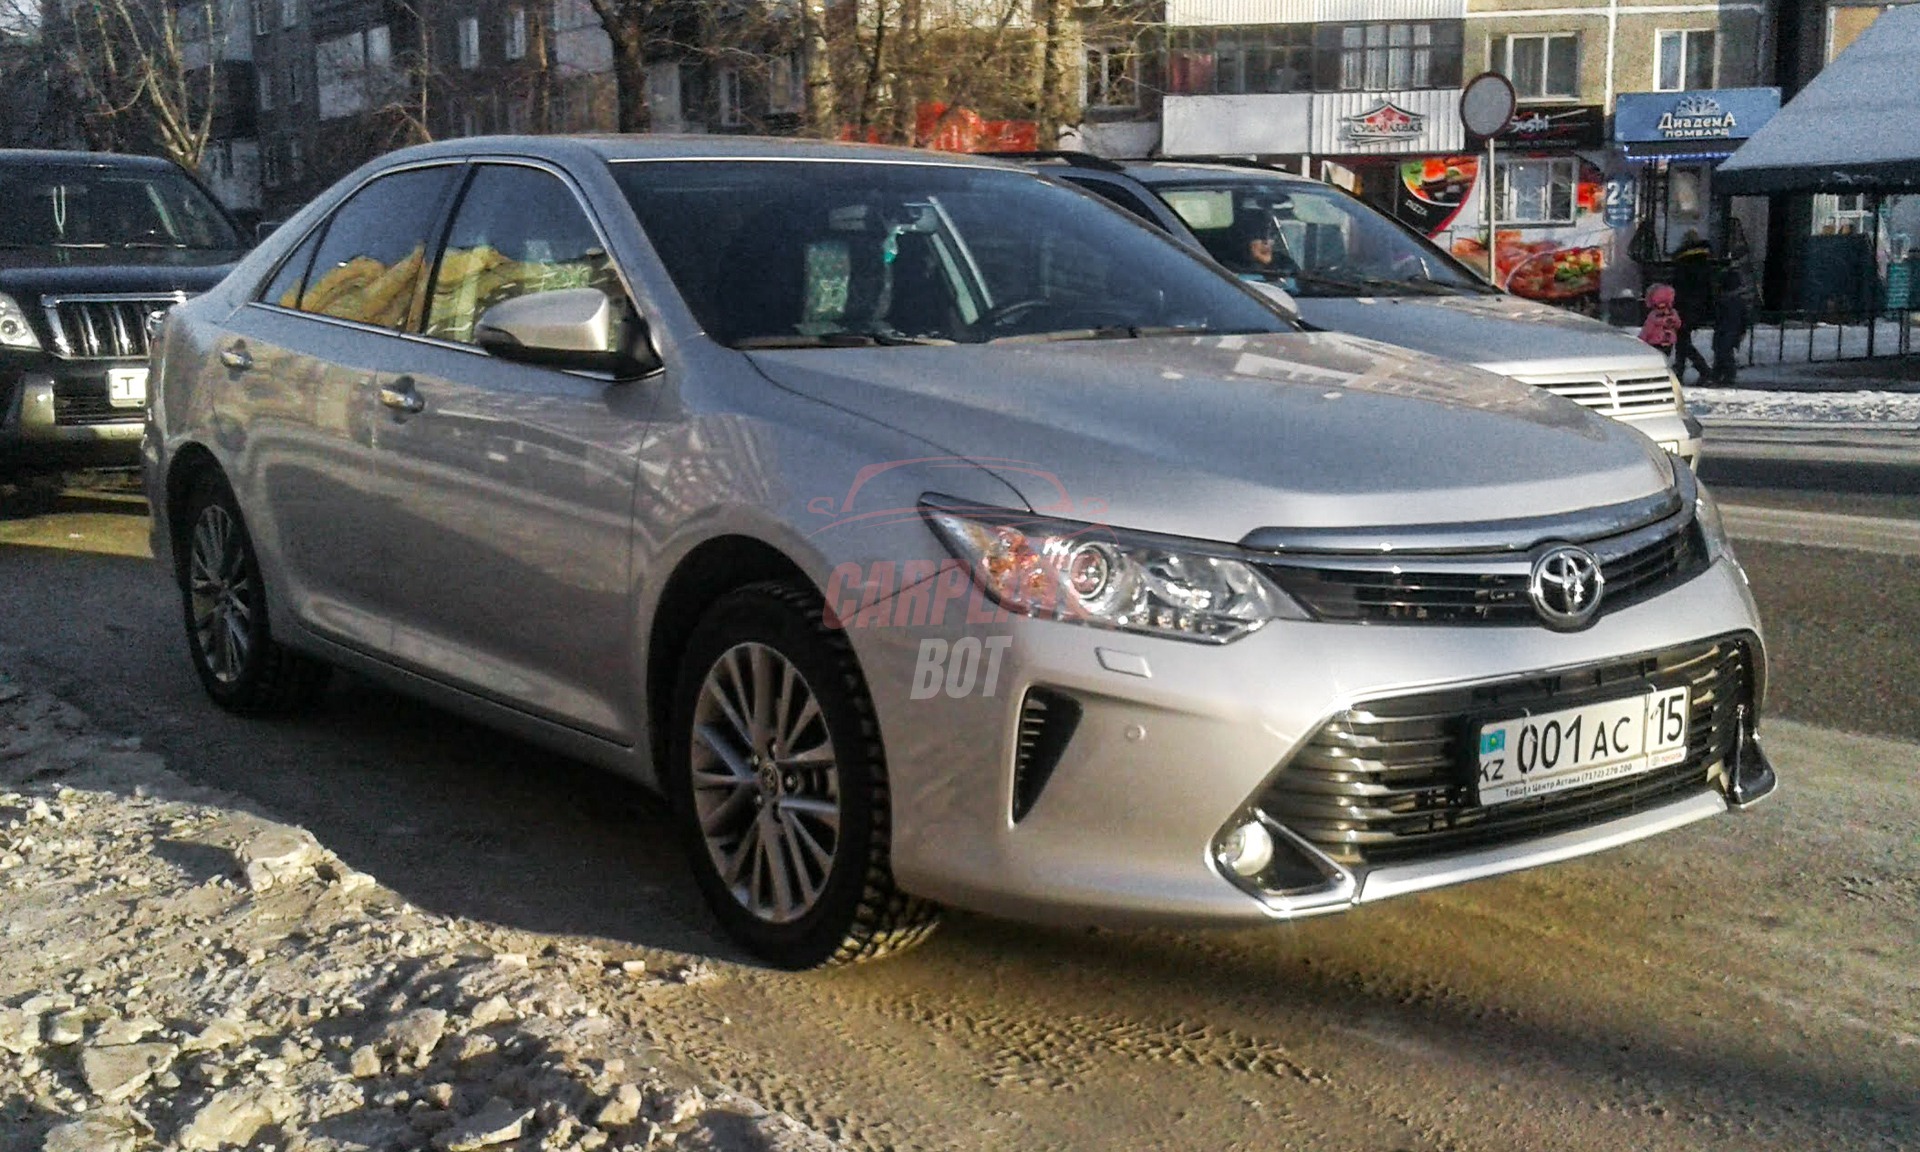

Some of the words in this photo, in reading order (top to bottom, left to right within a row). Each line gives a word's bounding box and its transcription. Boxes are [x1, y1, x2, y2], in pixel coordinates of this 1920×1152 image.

[1665, 128, 1729, 138] ЛОМБАРД
[1607, 182, 1634, 206] 24
[121, 377, 135, 395] T
[1517, 714, 1583, 775] 001
[1590, 716, 1631, 761] AC
[1650, 693, 1684, 745] 15
[1480, 759, 1504, 783] KZ
[1532, 780, 1555, 793] Центр
[1556, 776, 1580, 788] Астана
